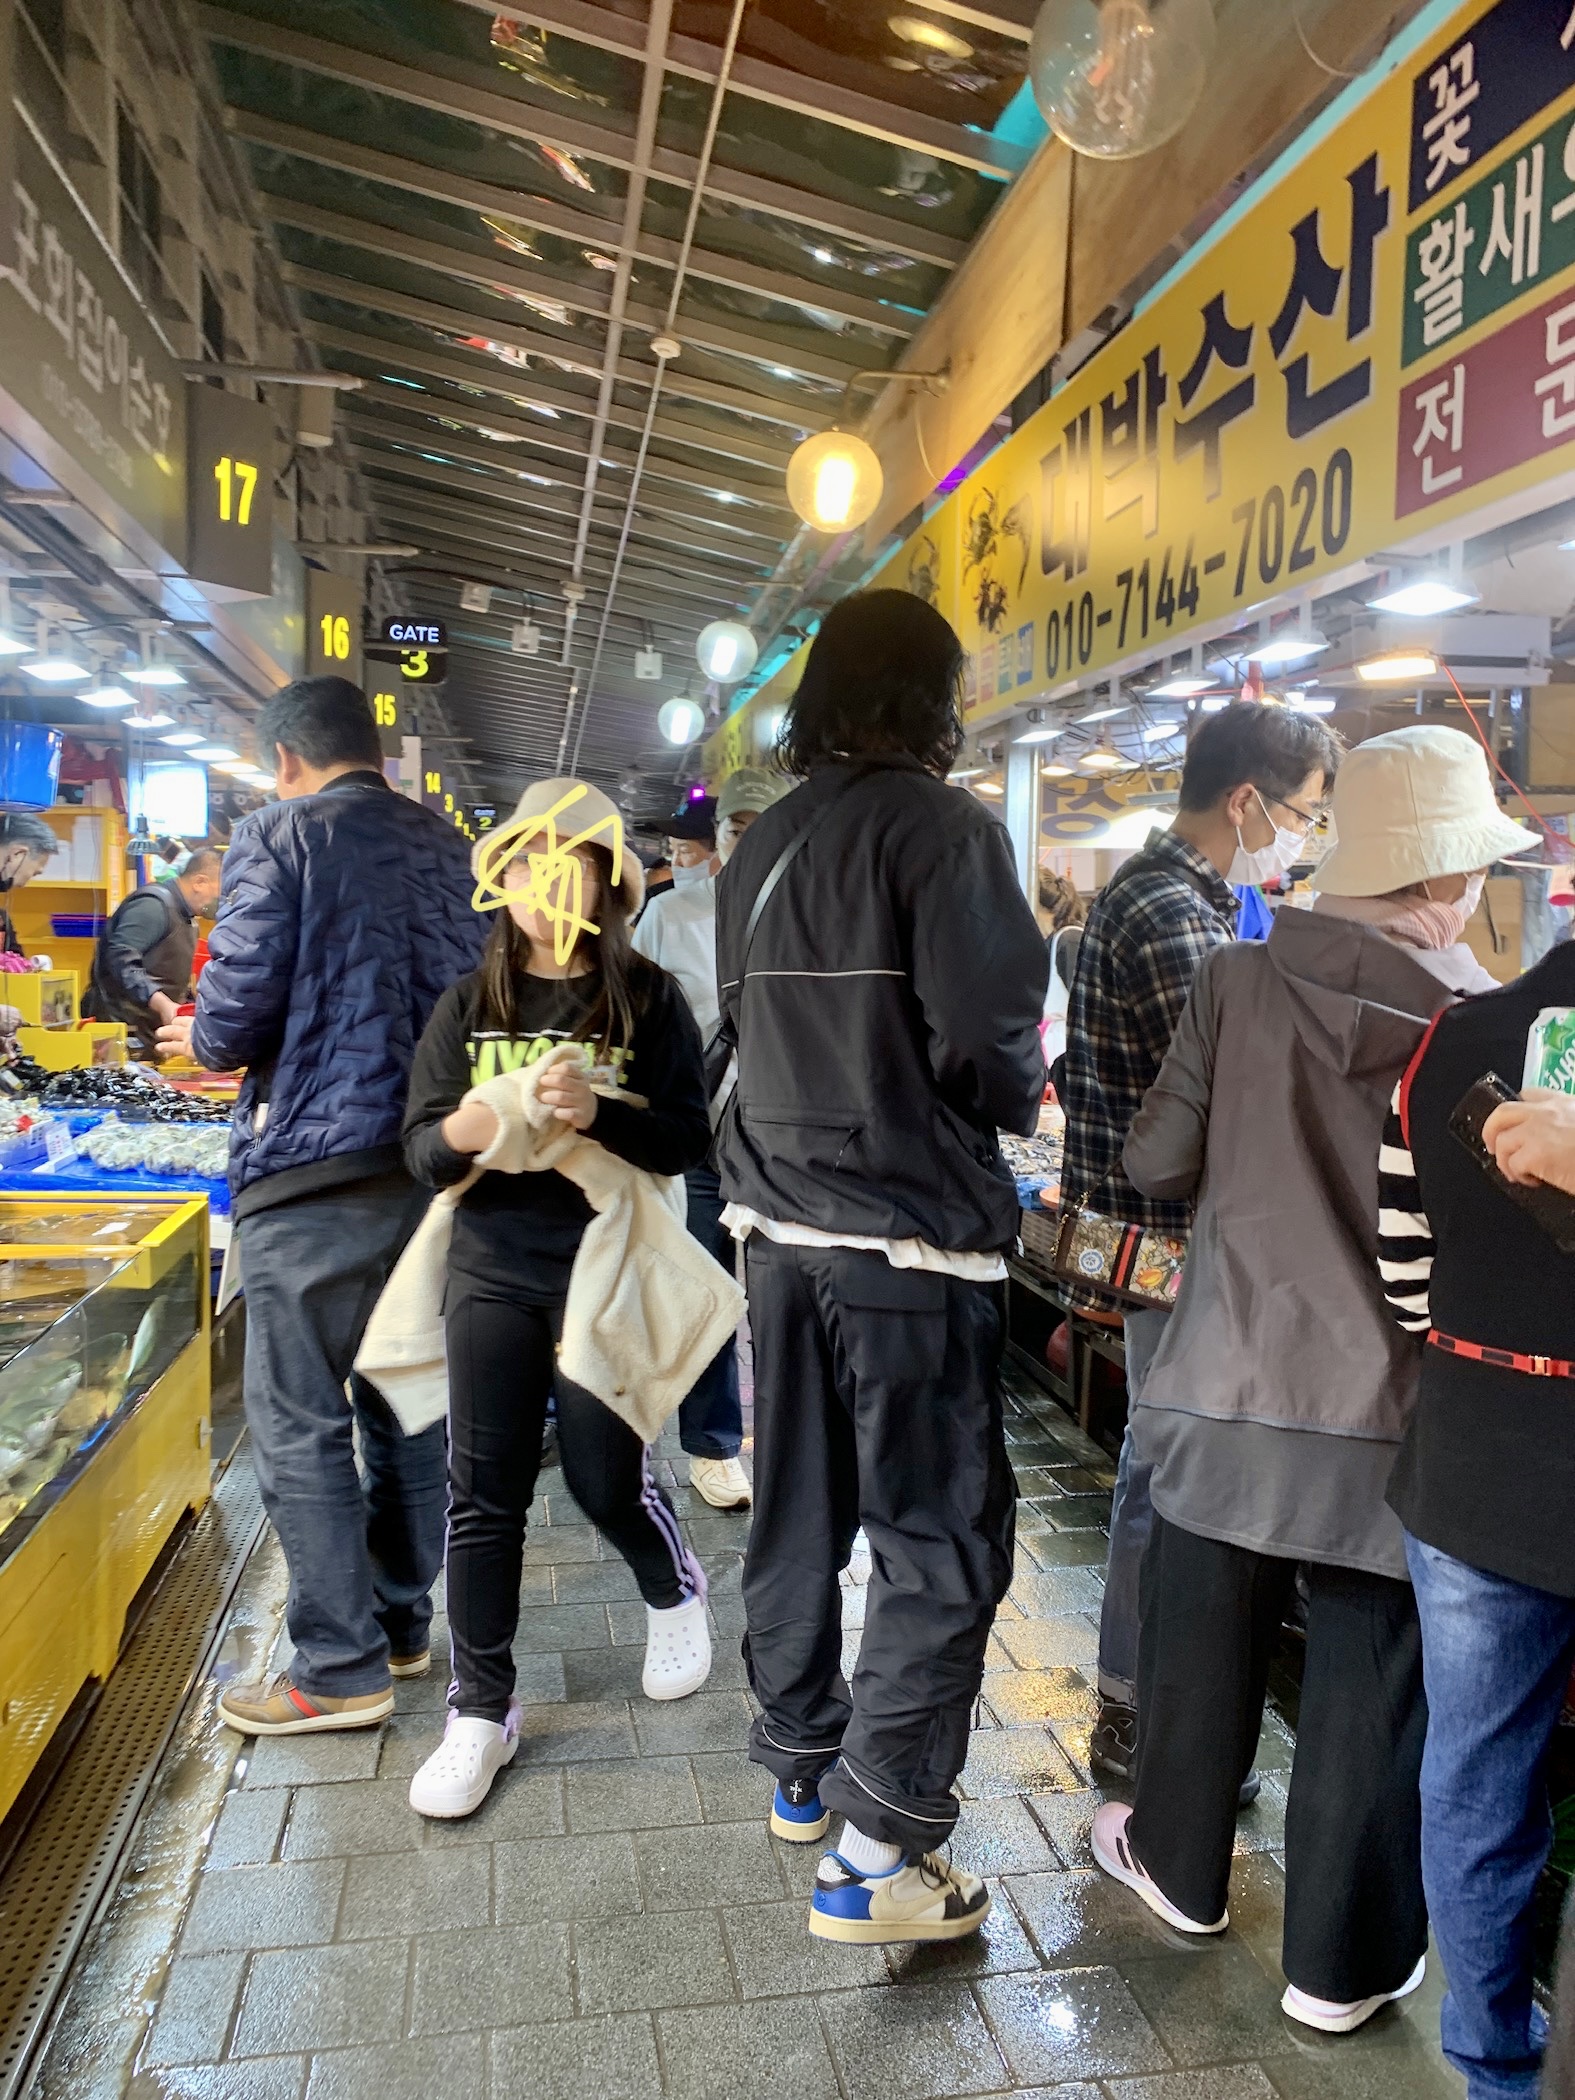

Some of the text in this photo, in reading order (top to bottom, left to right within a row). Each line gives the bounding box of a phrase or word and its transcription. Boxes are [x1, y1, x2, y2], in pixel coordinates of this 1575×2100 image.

[1422, 41, 1481, 192] 꽃
[1040, 150, 1390, 583] 대박수산
[1412, 363, 1466, 495] 전
[214, 457, 258, 526] 17
[1046, 447, 1353, 681] 010-7144-7020
[321, 614, 350, 660] 16
[389, 624, 440, 643] GATE
[400, 650, 429, 678] 3
[374, 693, 397, 726] 15
[425, 771, 442, 794] 14
[479, 816, 492, 831] 2
